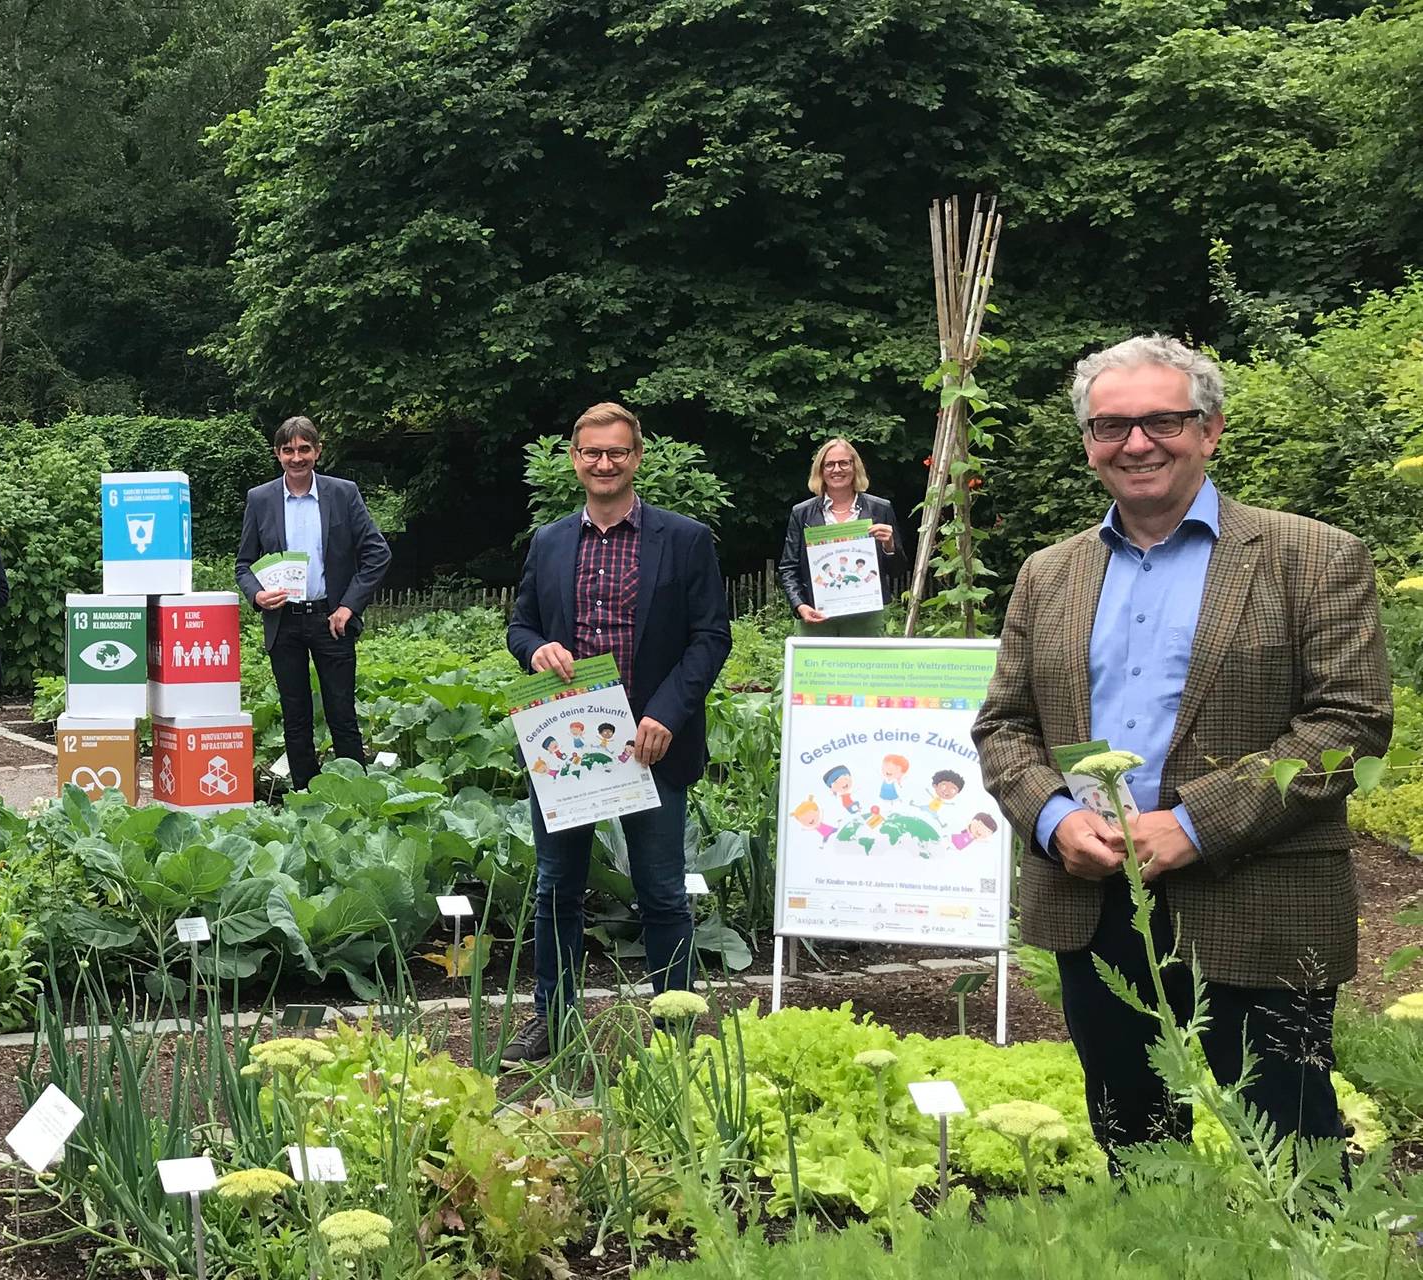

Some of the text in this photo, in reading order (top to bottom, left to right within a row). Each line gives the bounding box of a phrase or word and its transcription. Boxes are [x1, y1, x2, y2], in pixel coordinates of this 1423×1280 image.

[109, 490, 118, 506] 6
[73, 612, 88, 630] 13
[129, 612, 141, 620] ZUM
[171, 612, 178, 630] 1
[185, 612, 201, 620] KEINE
[93, 621, 132, 630] KLIMASCHUTZ
[185, 621, 204, 629] ARMUT
[804, 659, 993, 672] Ein Ferienprogramm für Weltretter:innen
[526, 705, 627, 743] Gestalte deine Zukunft!
[62, 736, 77, 752] 12
[187, 734, 196, 751] 9
[200, 733, 231, 741] INNOVATION
[200, 741, 244, 750] INFRASTRUKTUR
[799, 732, 868, 765] Gestalte
[873, 728, 921, 742] deine
